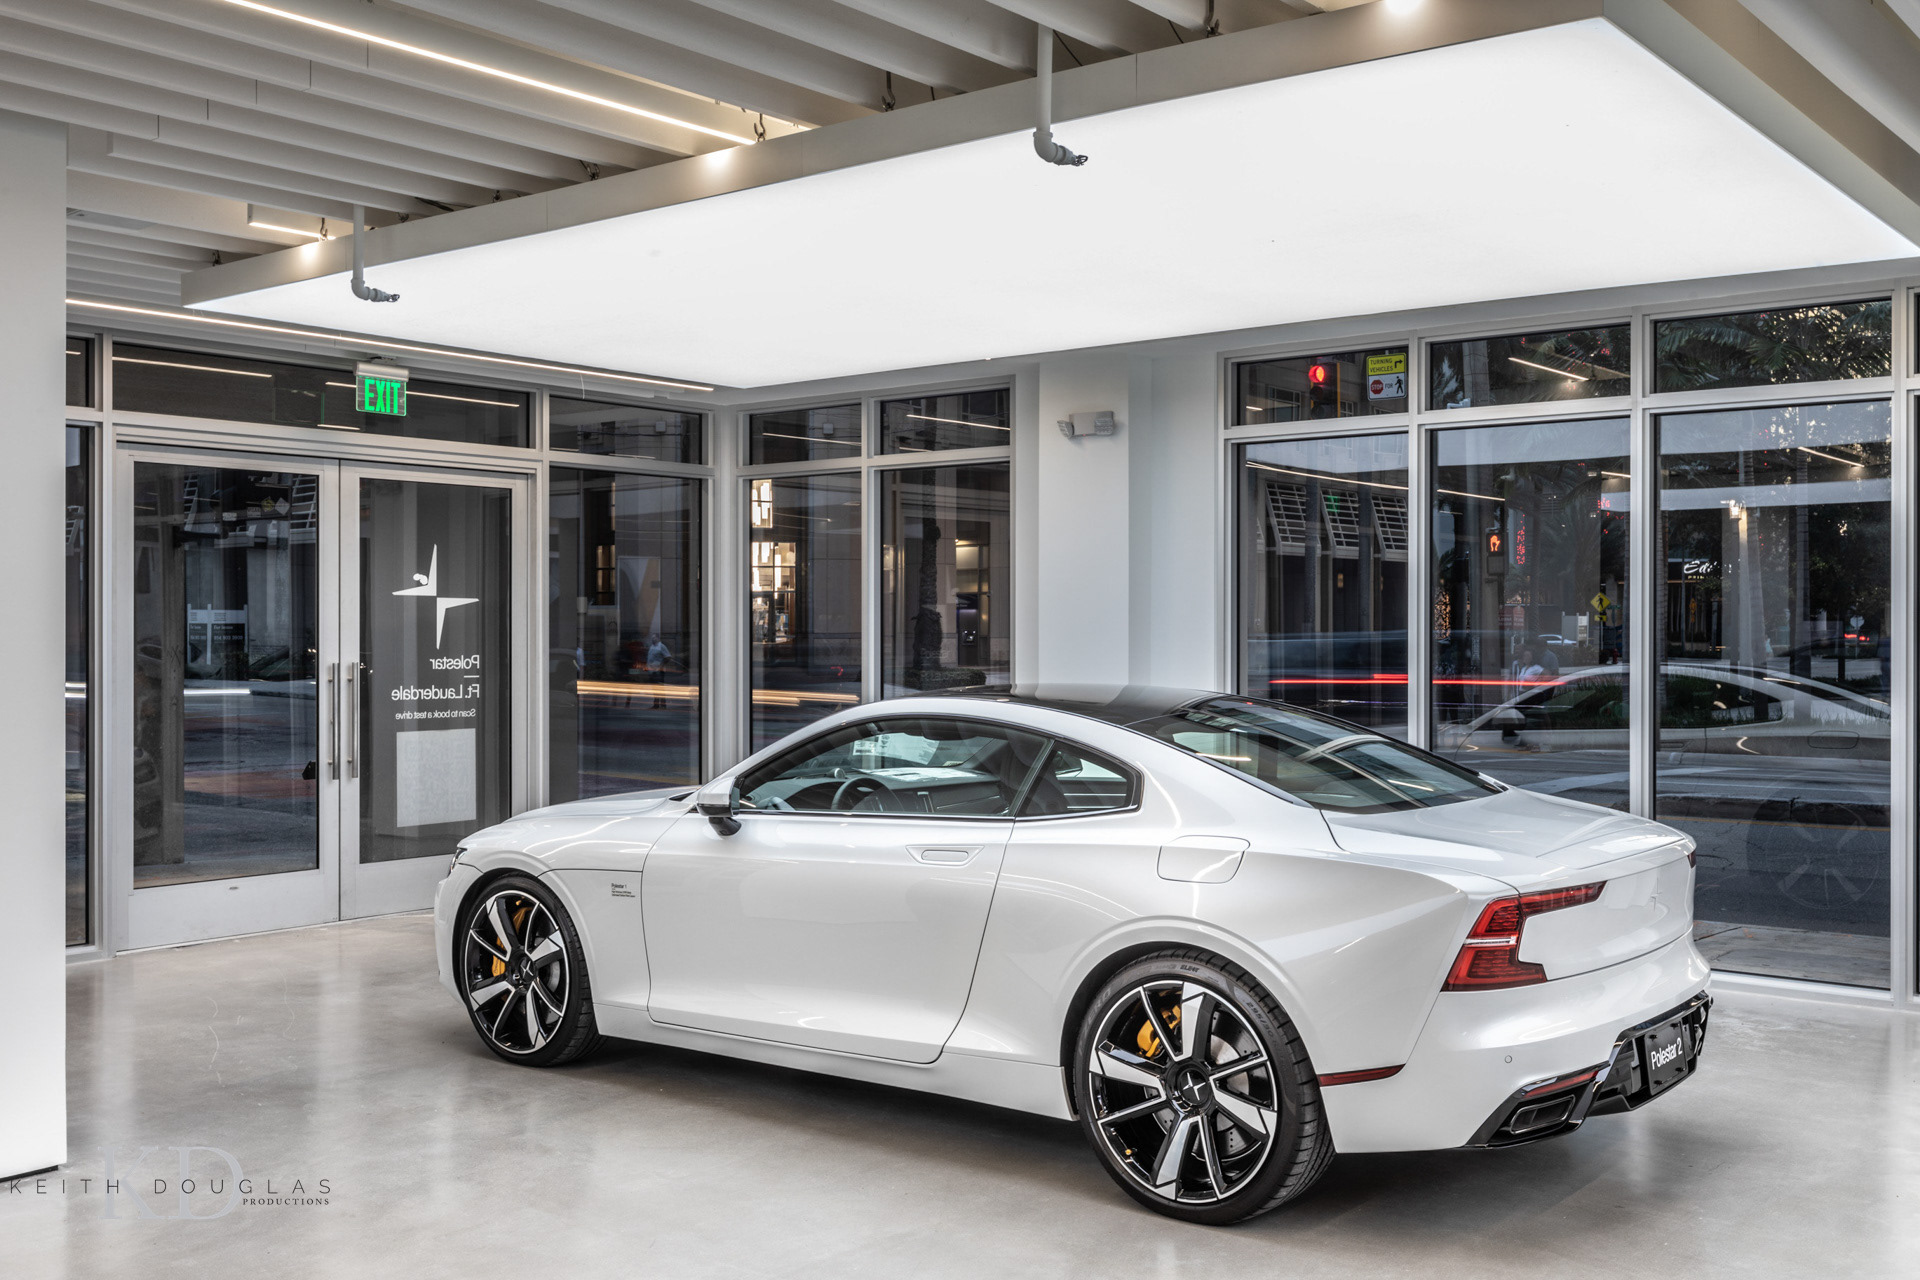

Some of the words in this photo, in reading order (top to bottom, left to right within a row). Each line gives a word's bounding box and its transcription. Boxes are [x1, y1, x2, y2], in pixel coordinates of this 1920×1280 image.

[365, 379, 401, 414] EXIT
[1651, 1044, 1677, 1070] Polestar
[1676, 1037, 1683, 1055] 2
